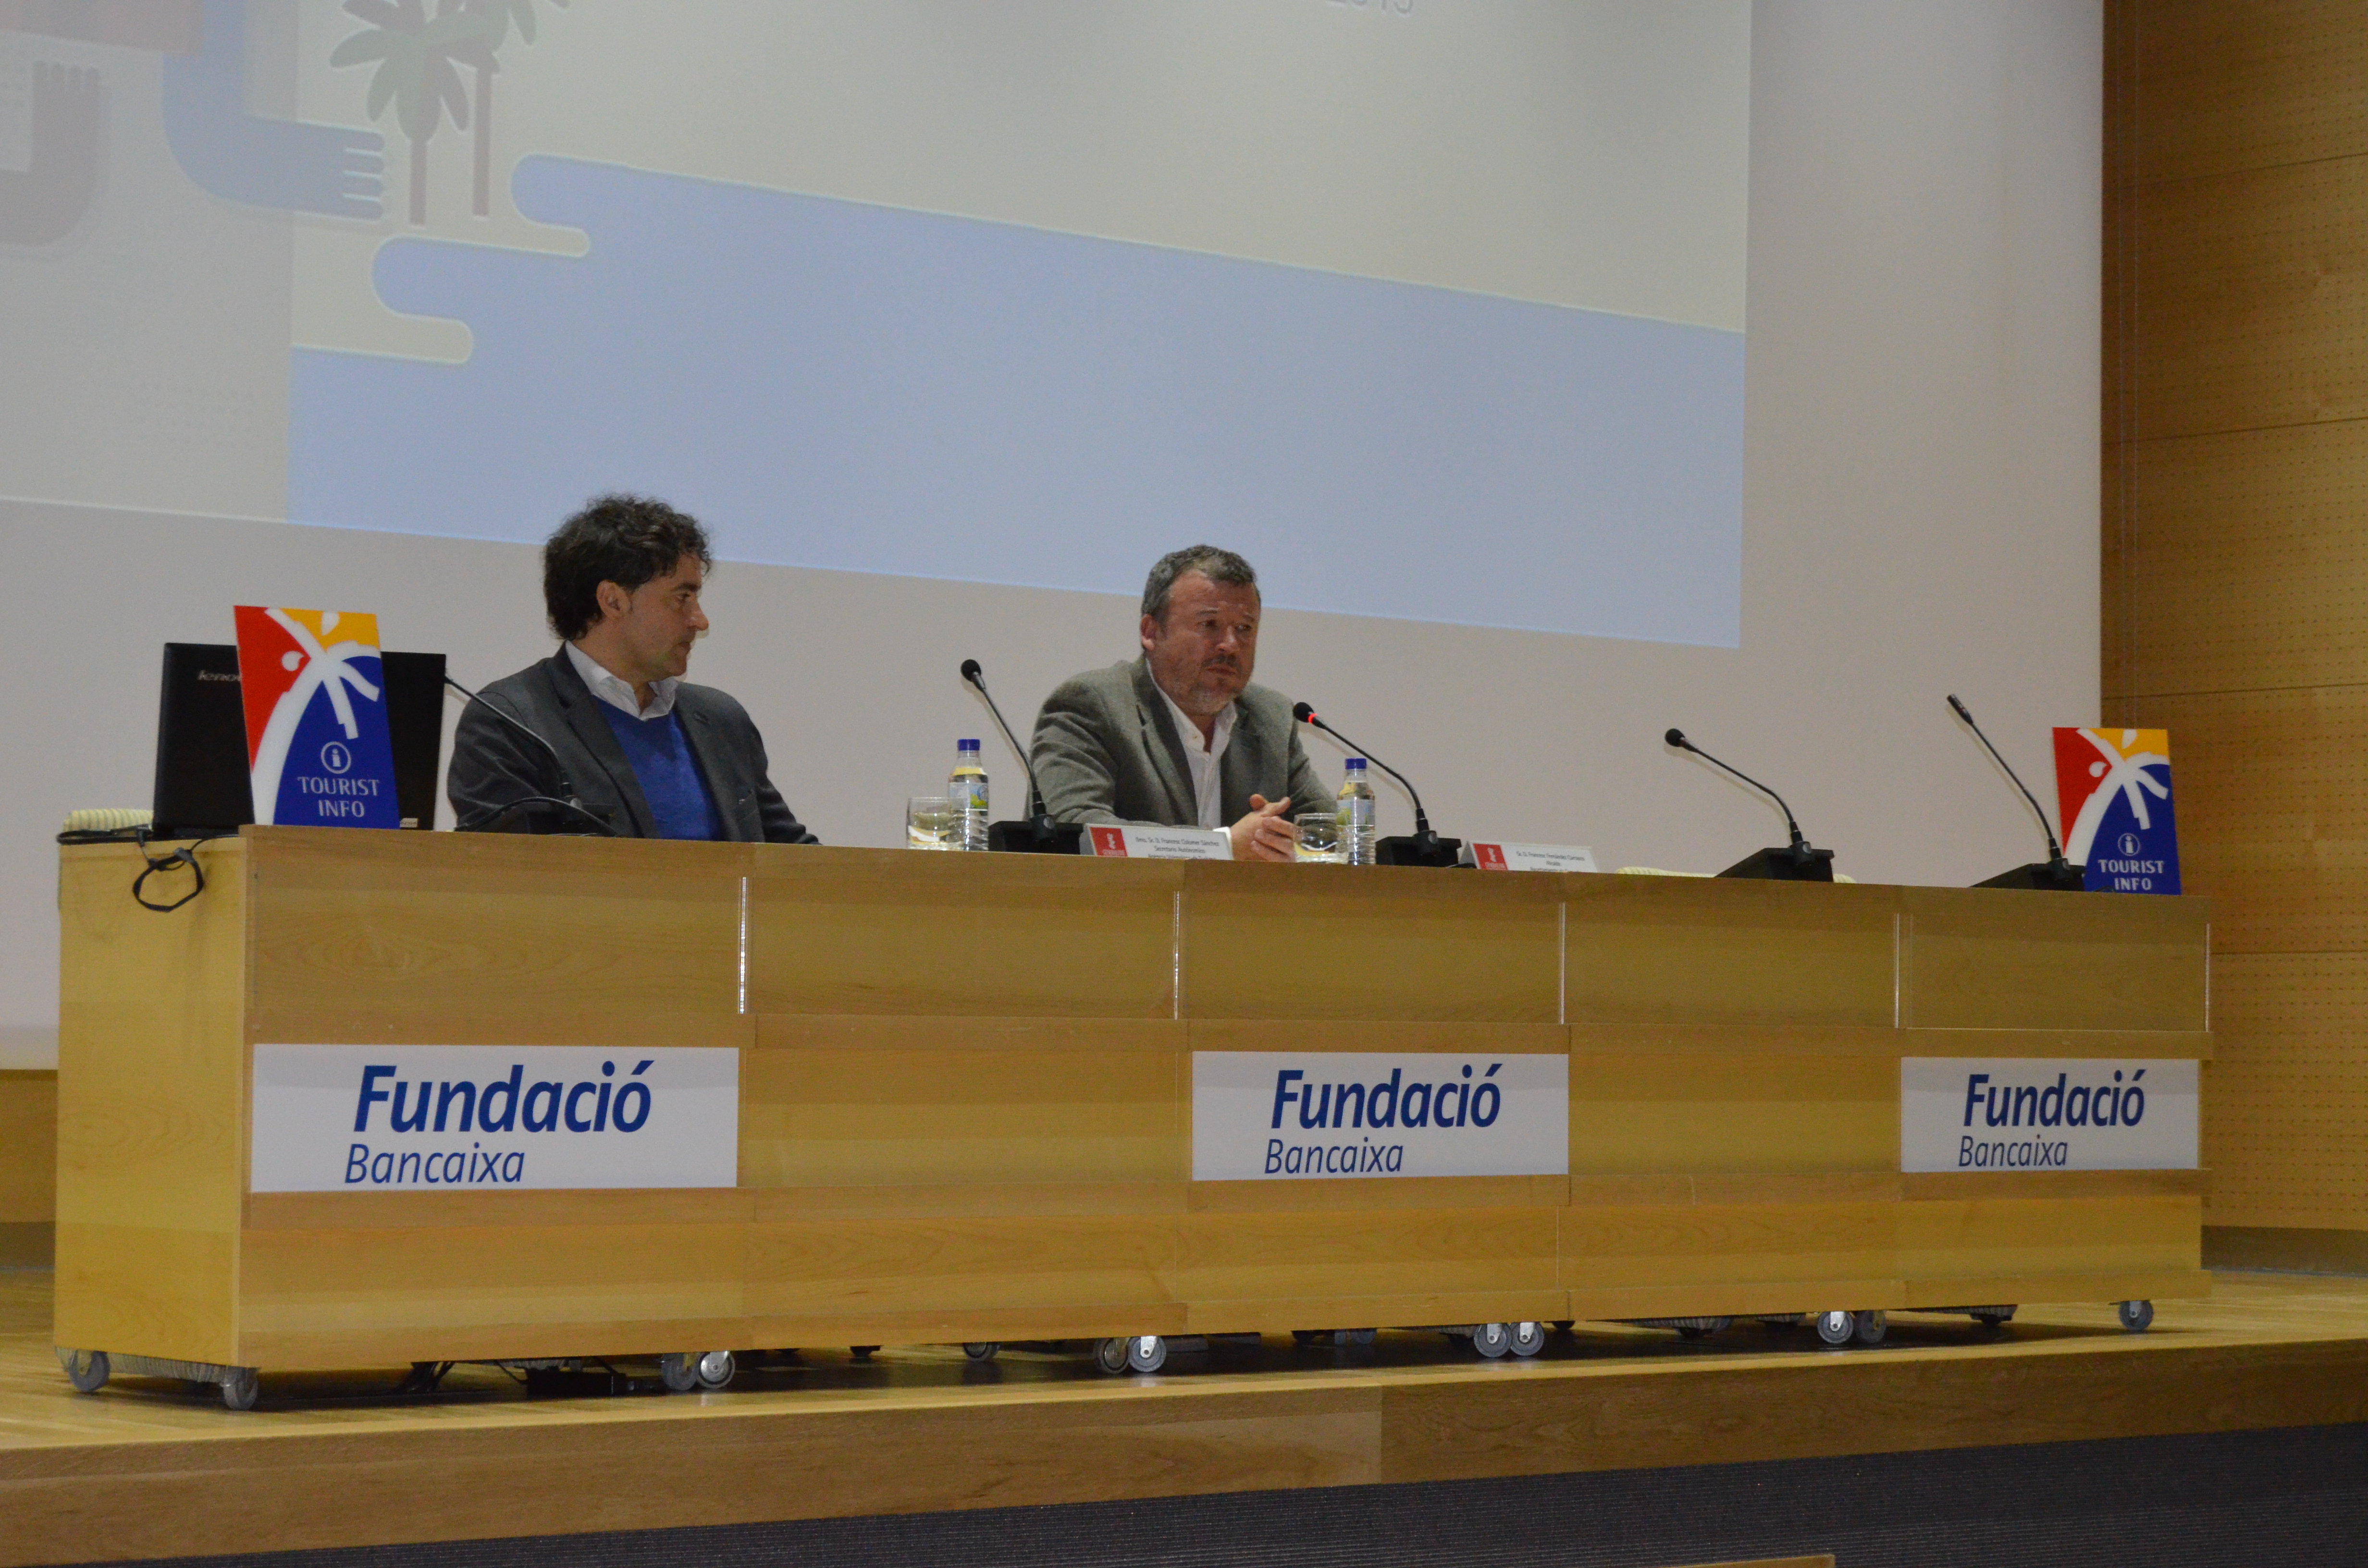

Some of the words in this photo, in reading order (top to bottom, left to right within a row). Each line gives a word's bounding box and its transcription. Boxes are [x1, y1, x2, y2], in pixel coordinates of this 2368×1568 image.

[197, 670, 240, 682] leno
[297, 776, 380, 796] TOURIST
[318, 800, 365, 818] INFO
[2098, 859, 2164, 874] TOURIST
[2114, 877, 2152, 891] INFO
[353, 1060, 655, 1133] Fundació
[1271, 1063, 1503, 1129] Fundació
[1963, 1068, 2147, 1127] Fundació
[345, 1142, 525, 1184] Bancaixa
[1264, 1136, 1404, 1174] Bancaixa
[1958, 1134, 2069, 1168] Bancaixa
